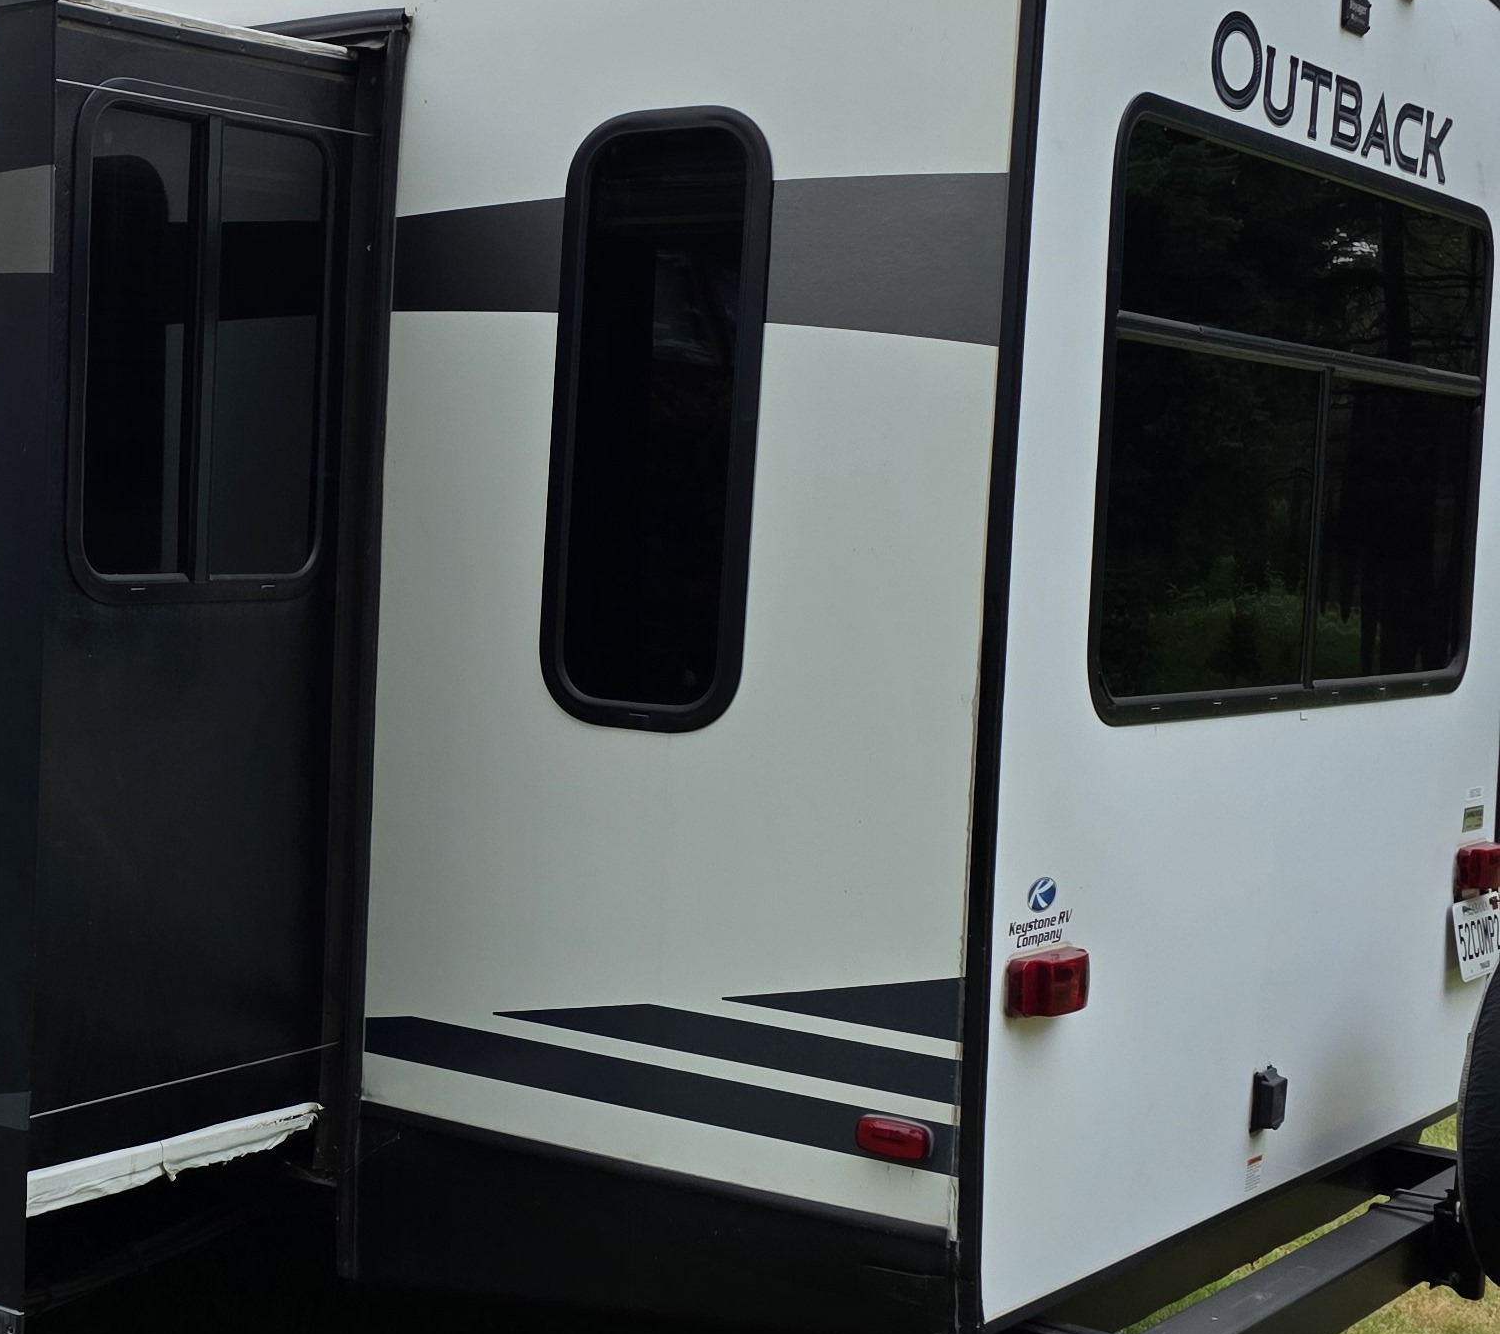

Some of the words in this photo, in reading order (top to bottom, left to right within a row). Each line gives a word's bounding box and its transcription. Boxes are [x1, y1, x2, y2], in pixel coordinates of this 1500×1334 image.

[1211, 10, 1453, 185] OUTBACK
[1008, 915, 1056, 936] Keystone
[1058, 909, 1073, 924] RV
[1016, 928, 1062, 948] Company
